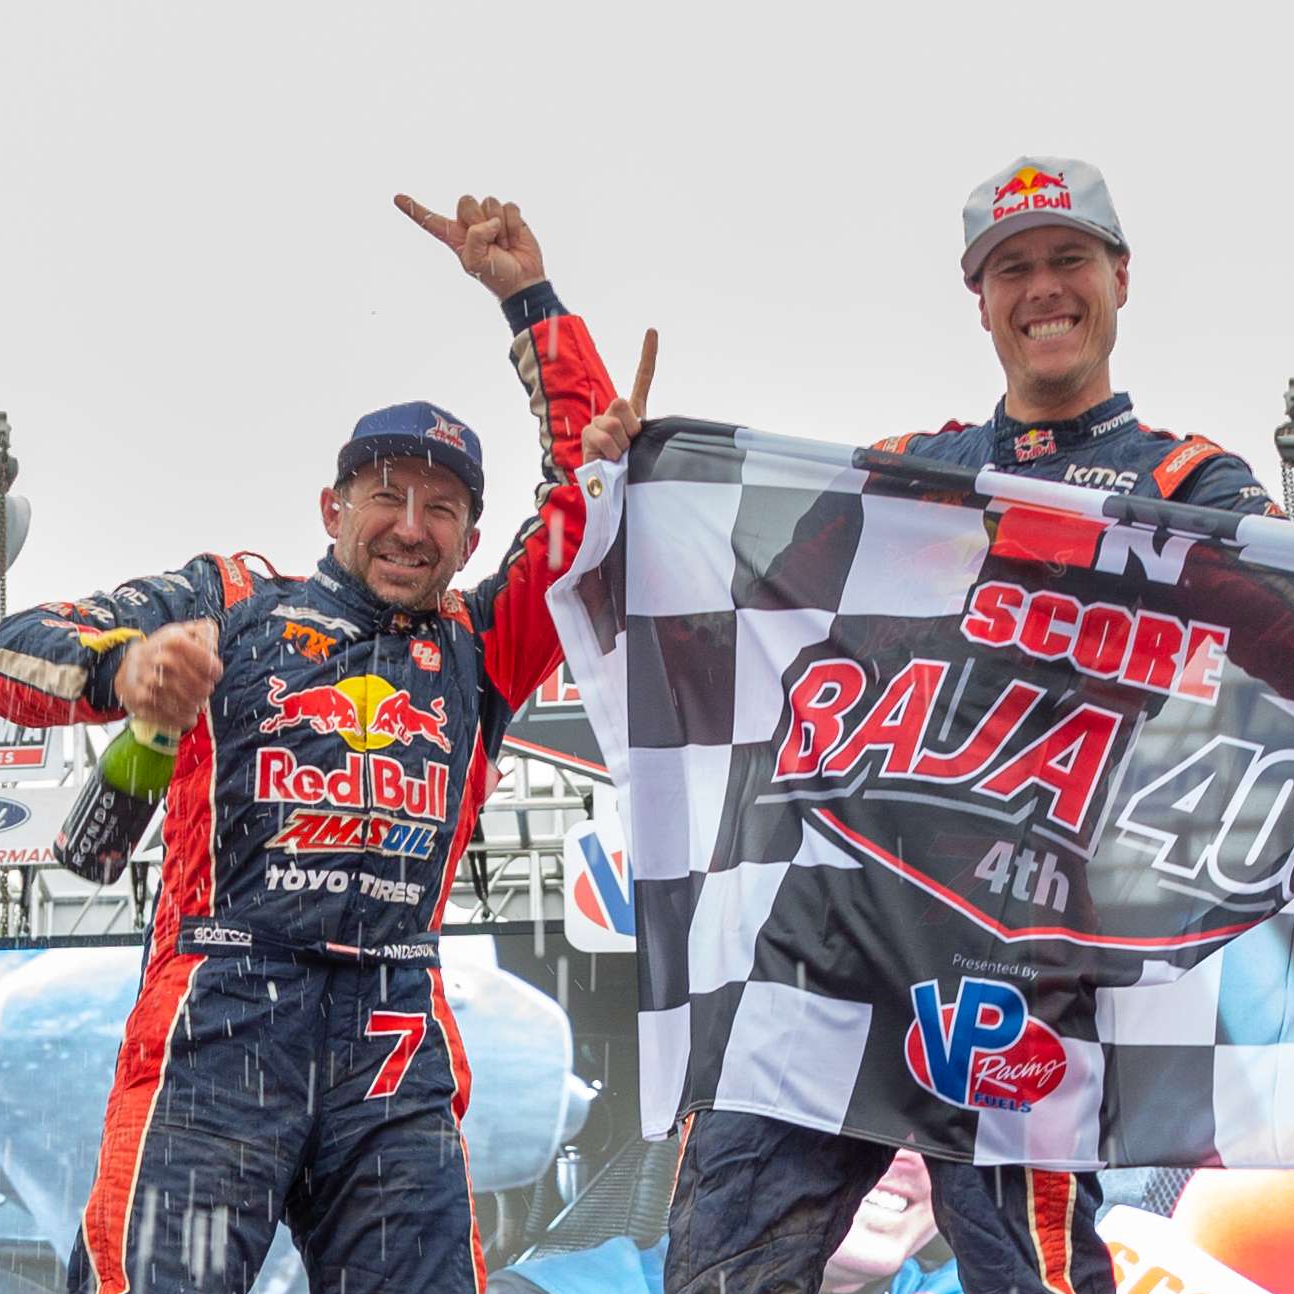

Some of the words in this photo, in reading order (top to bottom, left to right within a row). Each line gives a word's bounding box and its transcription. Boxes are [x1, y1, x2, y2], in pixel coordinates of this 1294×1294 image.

[1032, 192, 1072, 210] Bull
[960, 580, 1231, 706] SCORE
[771, 657, 1123, 834] BAJA
[254, 746, 366, 808] Red
[368, 752, 451, 823] Bull
[264, 808, 438, 860] AMSOIL
[266, 862, 350, 892] TOYO
[359, 872, 424, 906] TIRES
[974, 841, 1072, 913] 4th
[194, 926, 253, 944] sparco
[952, 953, 1019, 977] Presented
[1021, 966, 1039, 981] By
[364, 1010, 428, 1101] 7
[909, 975, 1029, 1106] VP
[975, 1053, 1068, 1093] Racing
[973, 1092, 1033, 1114] FUELS
